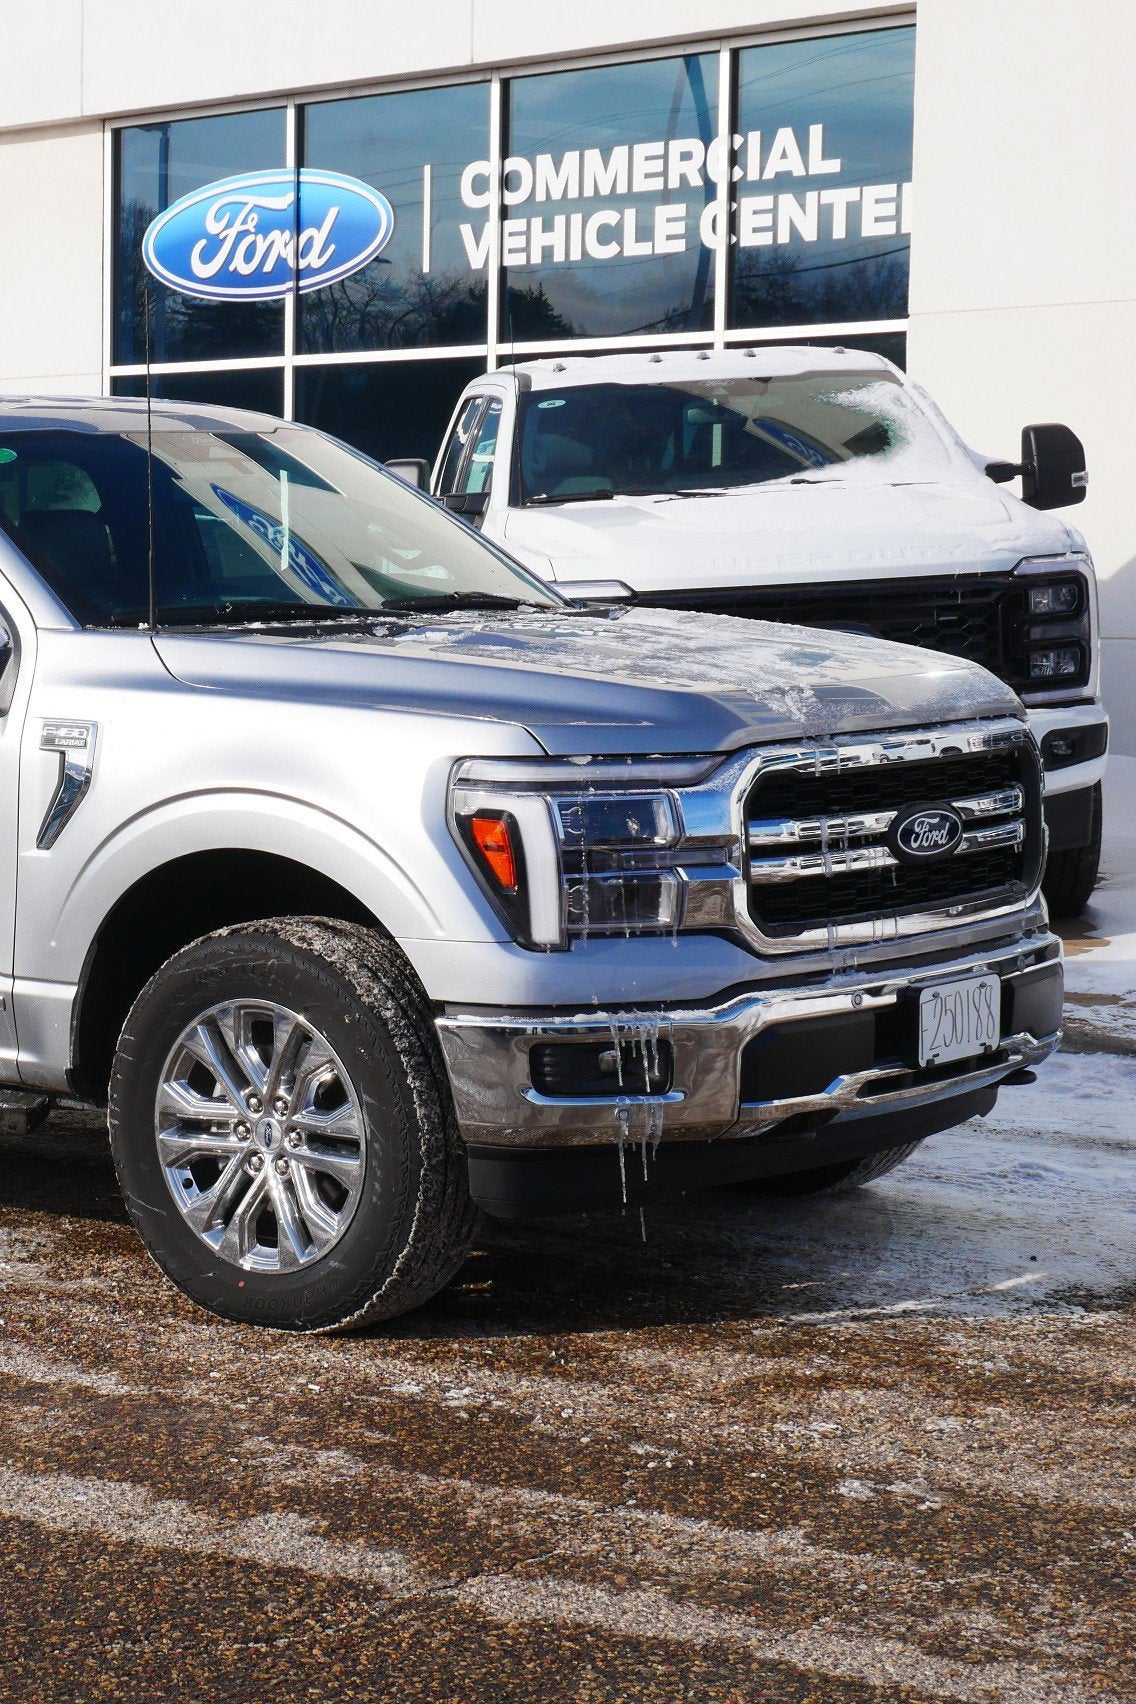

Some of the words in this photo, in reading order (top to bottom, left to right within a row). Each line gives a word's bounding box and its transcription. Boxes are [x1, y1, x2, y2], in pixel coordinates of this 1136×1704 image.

[461, 123, 841, 208] COMMERCIAL
[191, 191, 340, 279] Ford
[459, 203, 687, 269] VEHICLE
[55, 738, 85, 747] LARIAT
[911, 817, 950, 848] Ford
